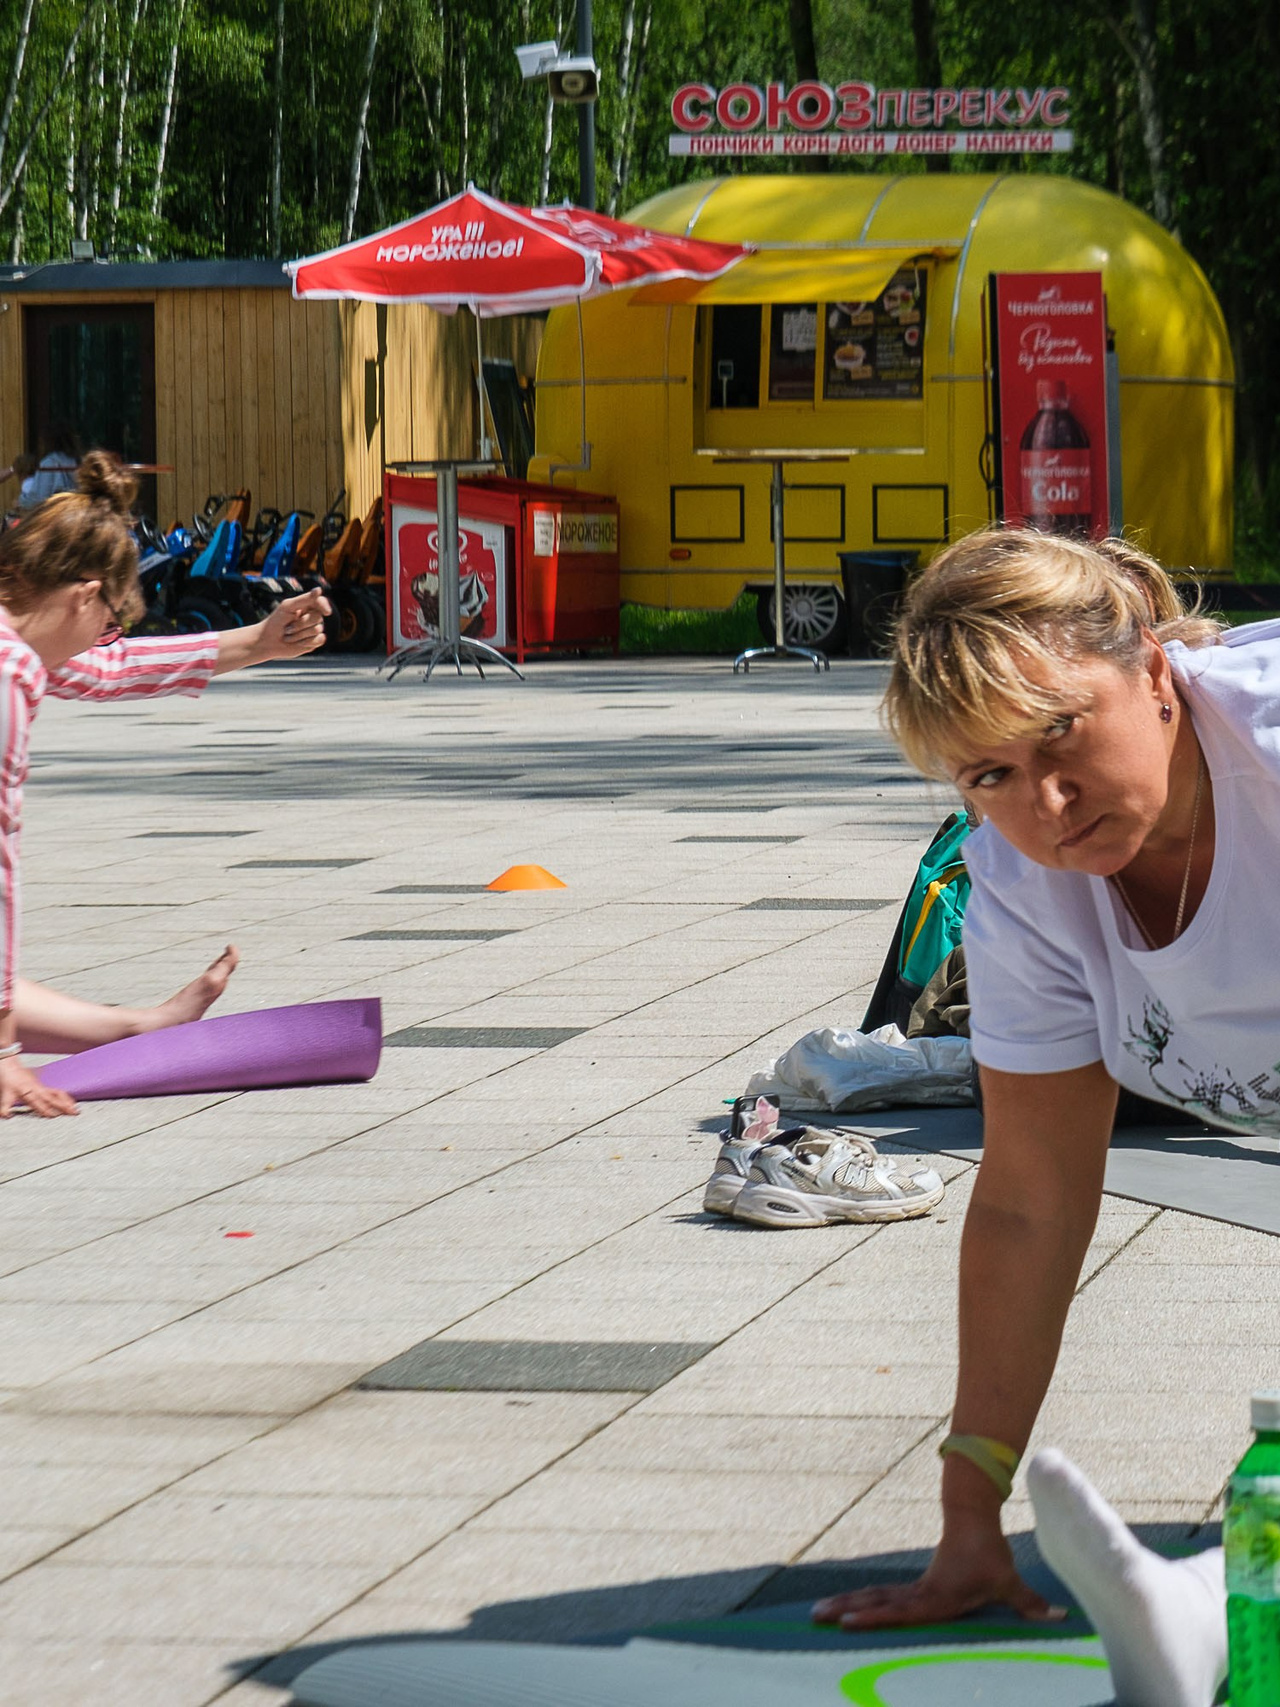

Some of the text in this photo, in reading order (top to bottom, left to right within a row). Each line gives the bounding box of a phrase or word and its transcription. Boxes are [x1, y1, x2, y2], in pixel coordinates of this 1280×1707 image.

[690, 132, 1053, 154] ПОНЧИКИ КОРН-ДОГИ ДОНЕР НАПИТКИ
[431, 221, 485, 244] УРА!!!
[1007, 299, 1094, 317] ЧЕРНОГОЛОВКА
[1032, 481, 1079, 502] Cola
[557, 521, 617, 544] МОРОЖЕНОЕ
